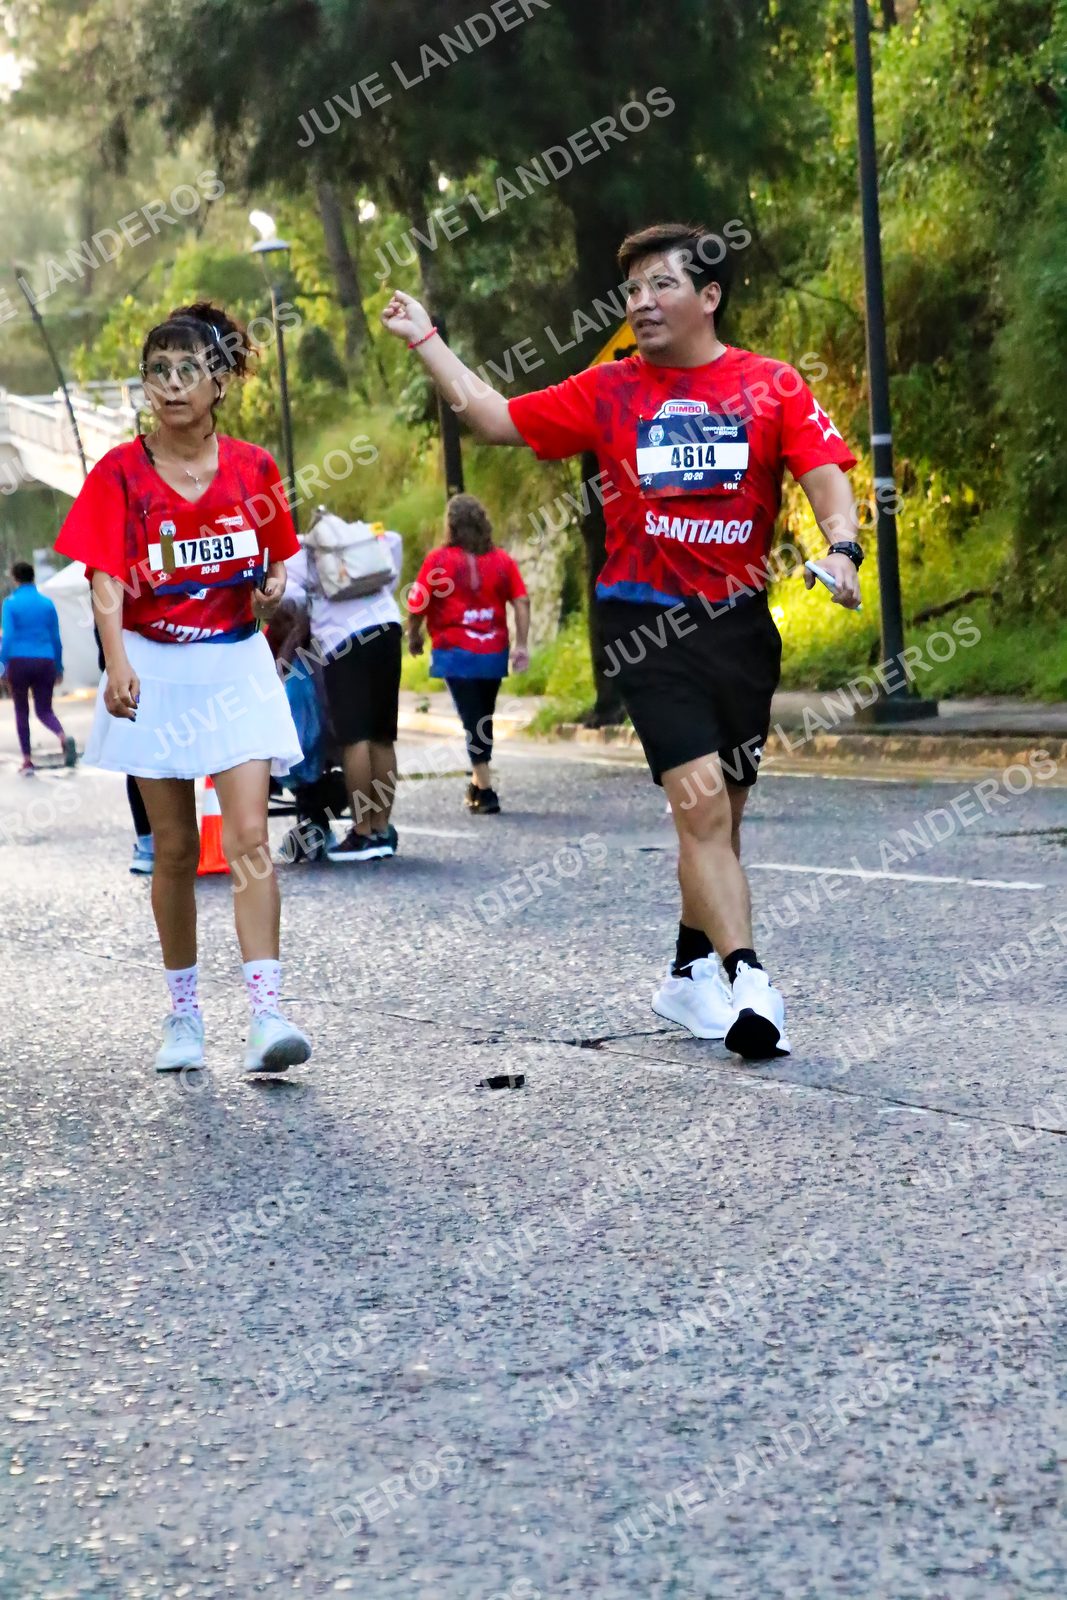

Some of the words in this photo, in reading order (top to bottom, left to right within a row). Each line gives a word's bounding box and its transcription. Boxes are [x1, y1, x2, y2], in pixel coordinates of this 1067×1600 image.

[668, 405, 702, 414] BIMBO
[671, 445, 716, 469] 4614
[723, 482, 738, 490] 10K
[645, 510, 753, 544] SANTIAGO
[179, 536, 235, 564] 17639
